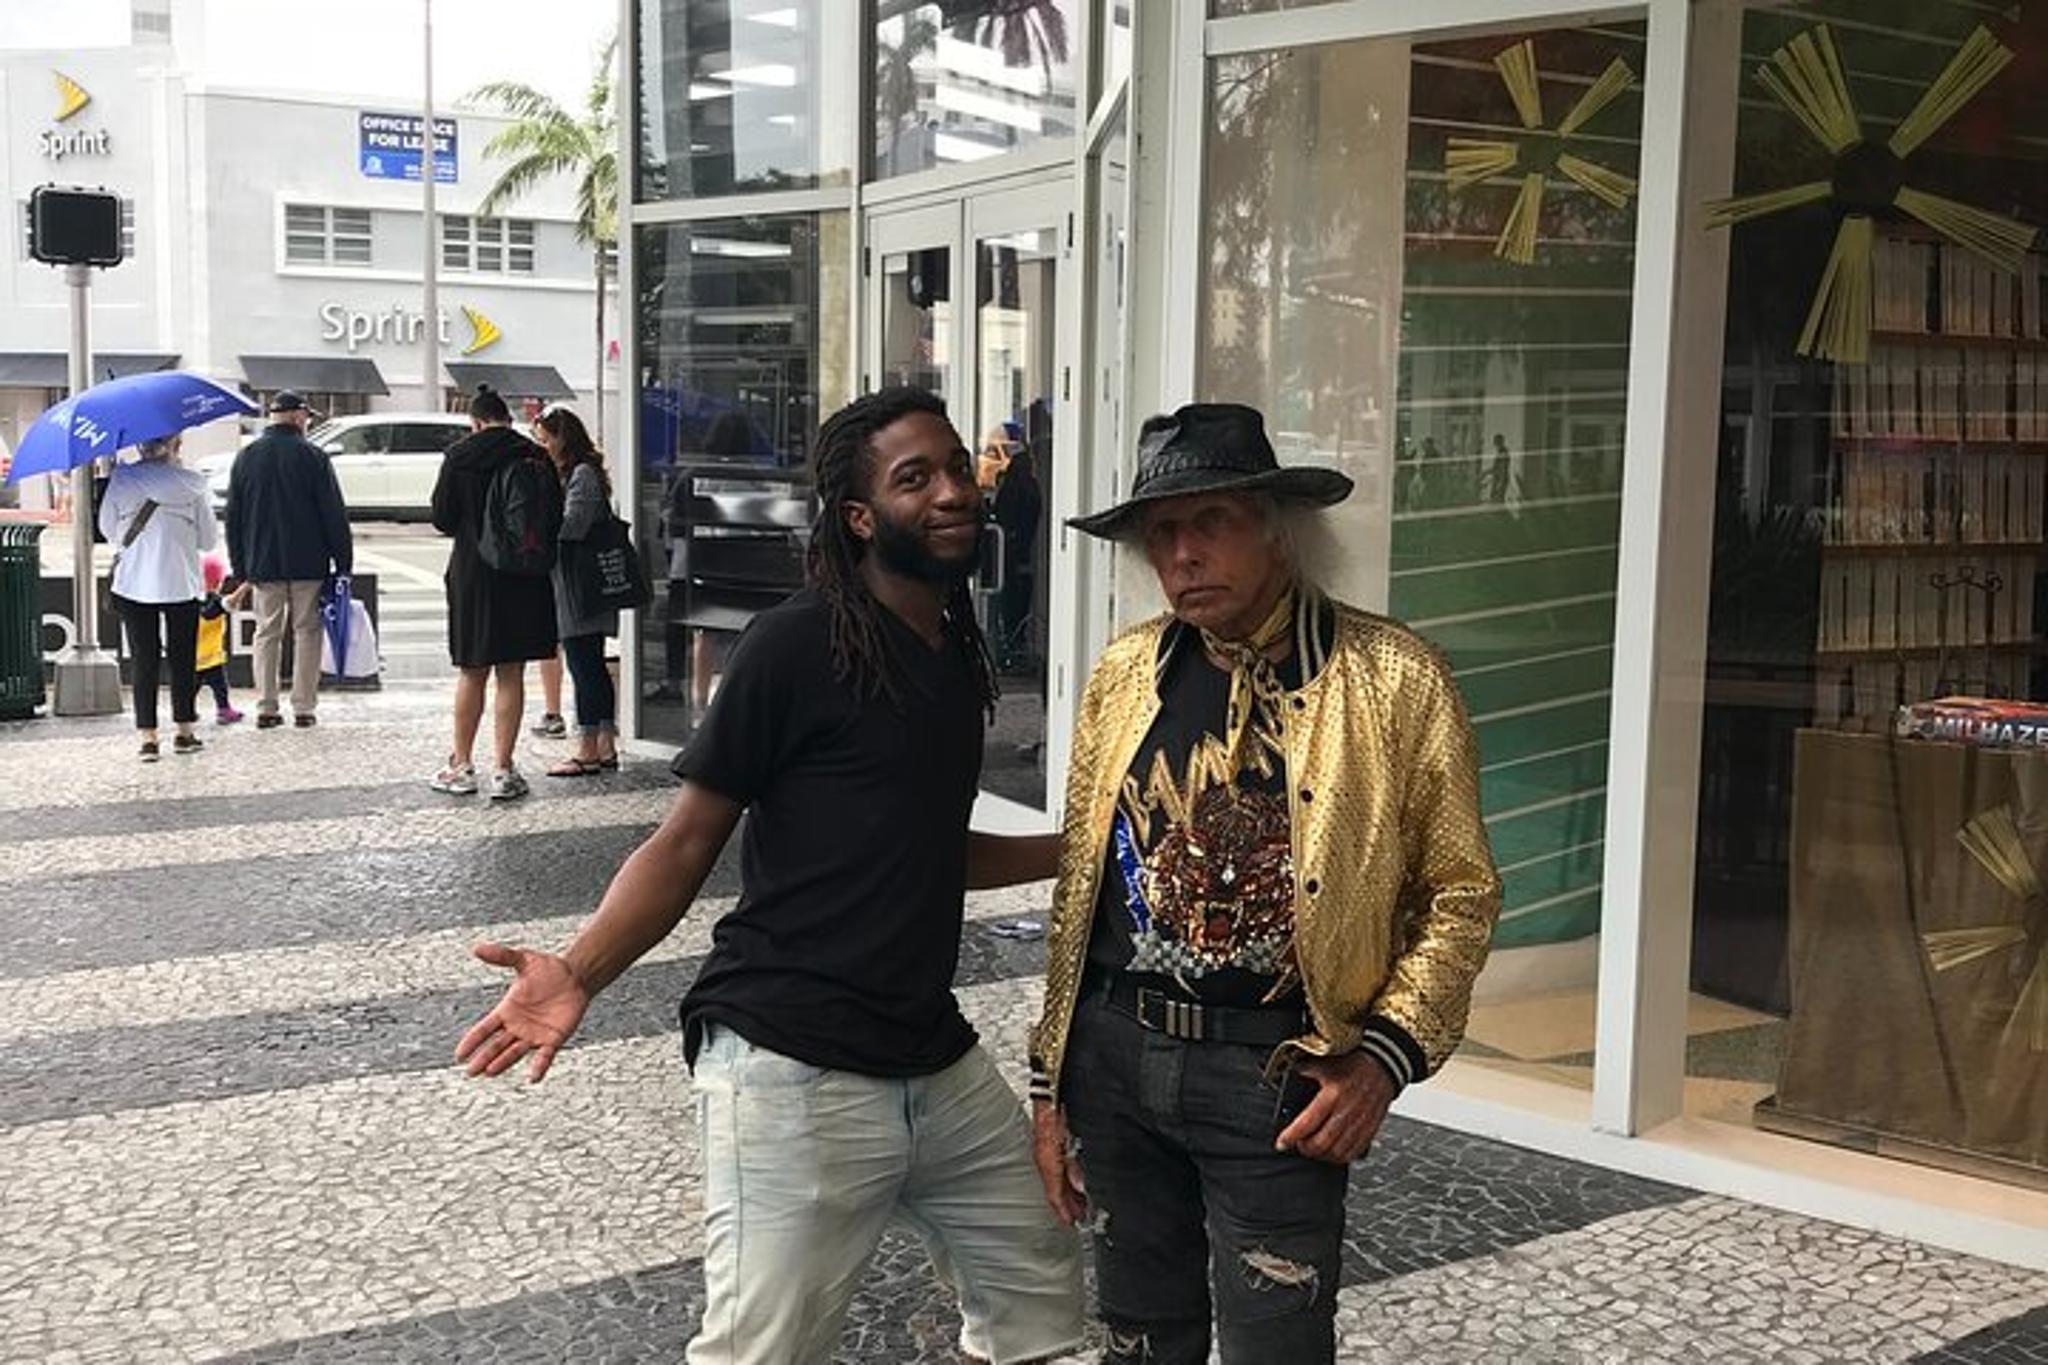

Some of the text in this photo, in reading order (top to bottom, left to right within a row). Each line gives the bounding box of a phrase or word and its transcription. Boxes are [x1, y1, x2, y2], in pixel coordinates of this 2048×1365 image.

[363, 116, 410, 131] OFFICE
[39, 129, 110, 161] Sprint
[368, 133, 400, 148] FOR
[321, 302, 451, 351] Sprint
